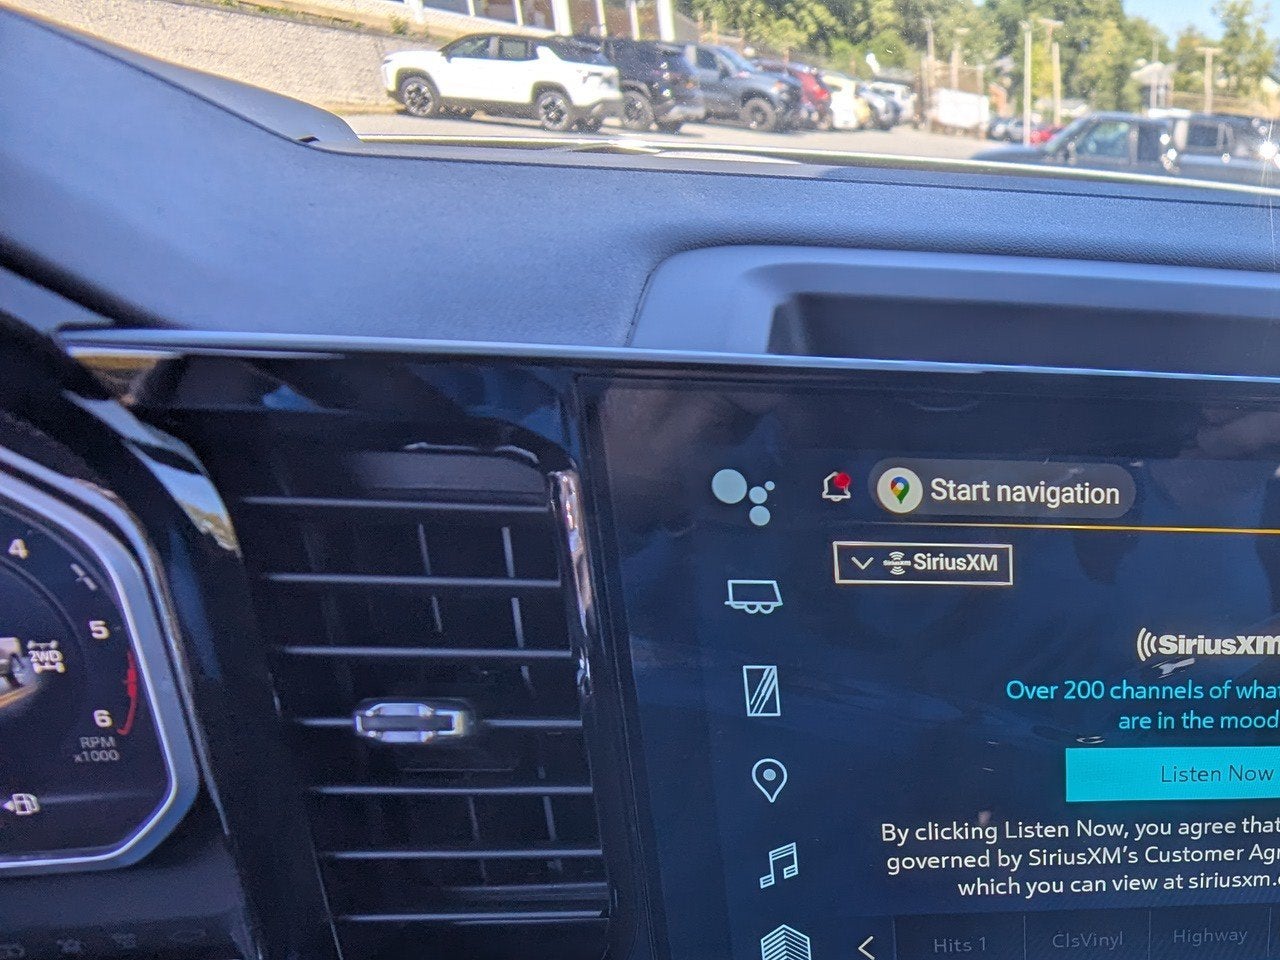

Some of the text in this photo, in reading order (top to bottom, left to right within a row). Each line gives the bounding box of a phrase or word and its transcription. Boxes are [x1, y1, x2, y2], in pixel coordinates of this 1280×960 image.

[930, 478, 1120, 508] Start navigation
[8, 538, 29, 559] 4
[913, 553, 998, 572] SiriusXM
[88, 620, 110, 640] 5
[1006, 680, 1059, 700] Over
[1064, 680, 1105, 700] 200
[1110, 679, 1204, 700] channels
[1209, 679, 1232, 699] of
[93, 709, 113, 728] 6
[1119, 715, 1151, 730] are
[1158, 710, 1175, 729] in
[1181, 710, 1214, 729] the
[1220, 709, 1279, 729] mood
[79, 736, 117, 749] RPM
[73, 750, 120, 763] x1000
[1161, 764, 1275, 783] Listen Now
[881, 822, 910, 846] By
[915, 821, 998, 845] clicking
[1004, 820, 1070, 839] Listen
[1076, 819, 1129, 840] Now,
[1134, 821, 1172, 841] you
[1178, 820, 1237, 839] agree
[886, 849, 991, 875] governed
[997, 848, 1023, 872] by
[1145, 845, 1245, 864] Customer
[957, 875, 1021, 897] which
[1024, 877, 1064, 899] you
[1070, 877, 1107, 893] can
[1112, 875, 1158, 891] view
[1162, 875, 1184, 890] at
[933, 936, 987, 954] Hits 1
[1051, 930, 1124, 951] ClsVinyl
[1173, 927, 1249, 947] Highway
